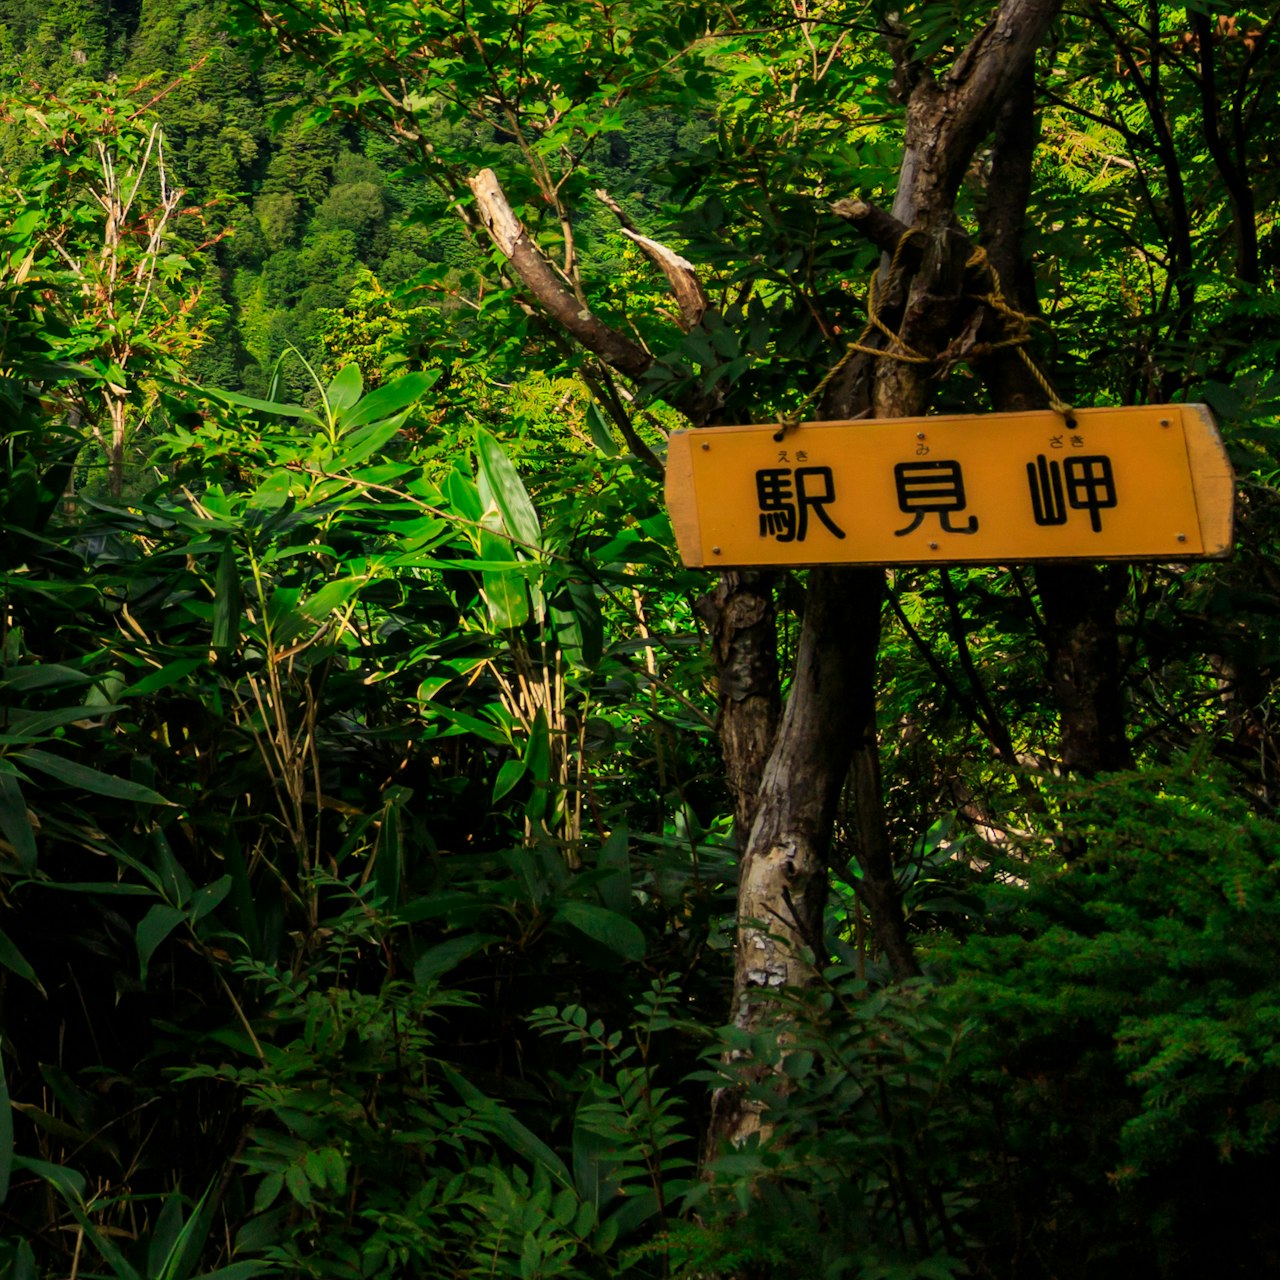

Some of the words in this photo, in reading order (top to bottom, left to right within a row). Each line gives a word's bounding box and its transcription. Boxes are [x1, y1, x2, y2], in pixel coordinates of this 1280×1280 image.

[777, 450, 808, 463] えき
[916, 443, 930, 456] み
[1049, 434, 1084, 449] ざき
[755, 454, 1119, 543] 駅見岬
